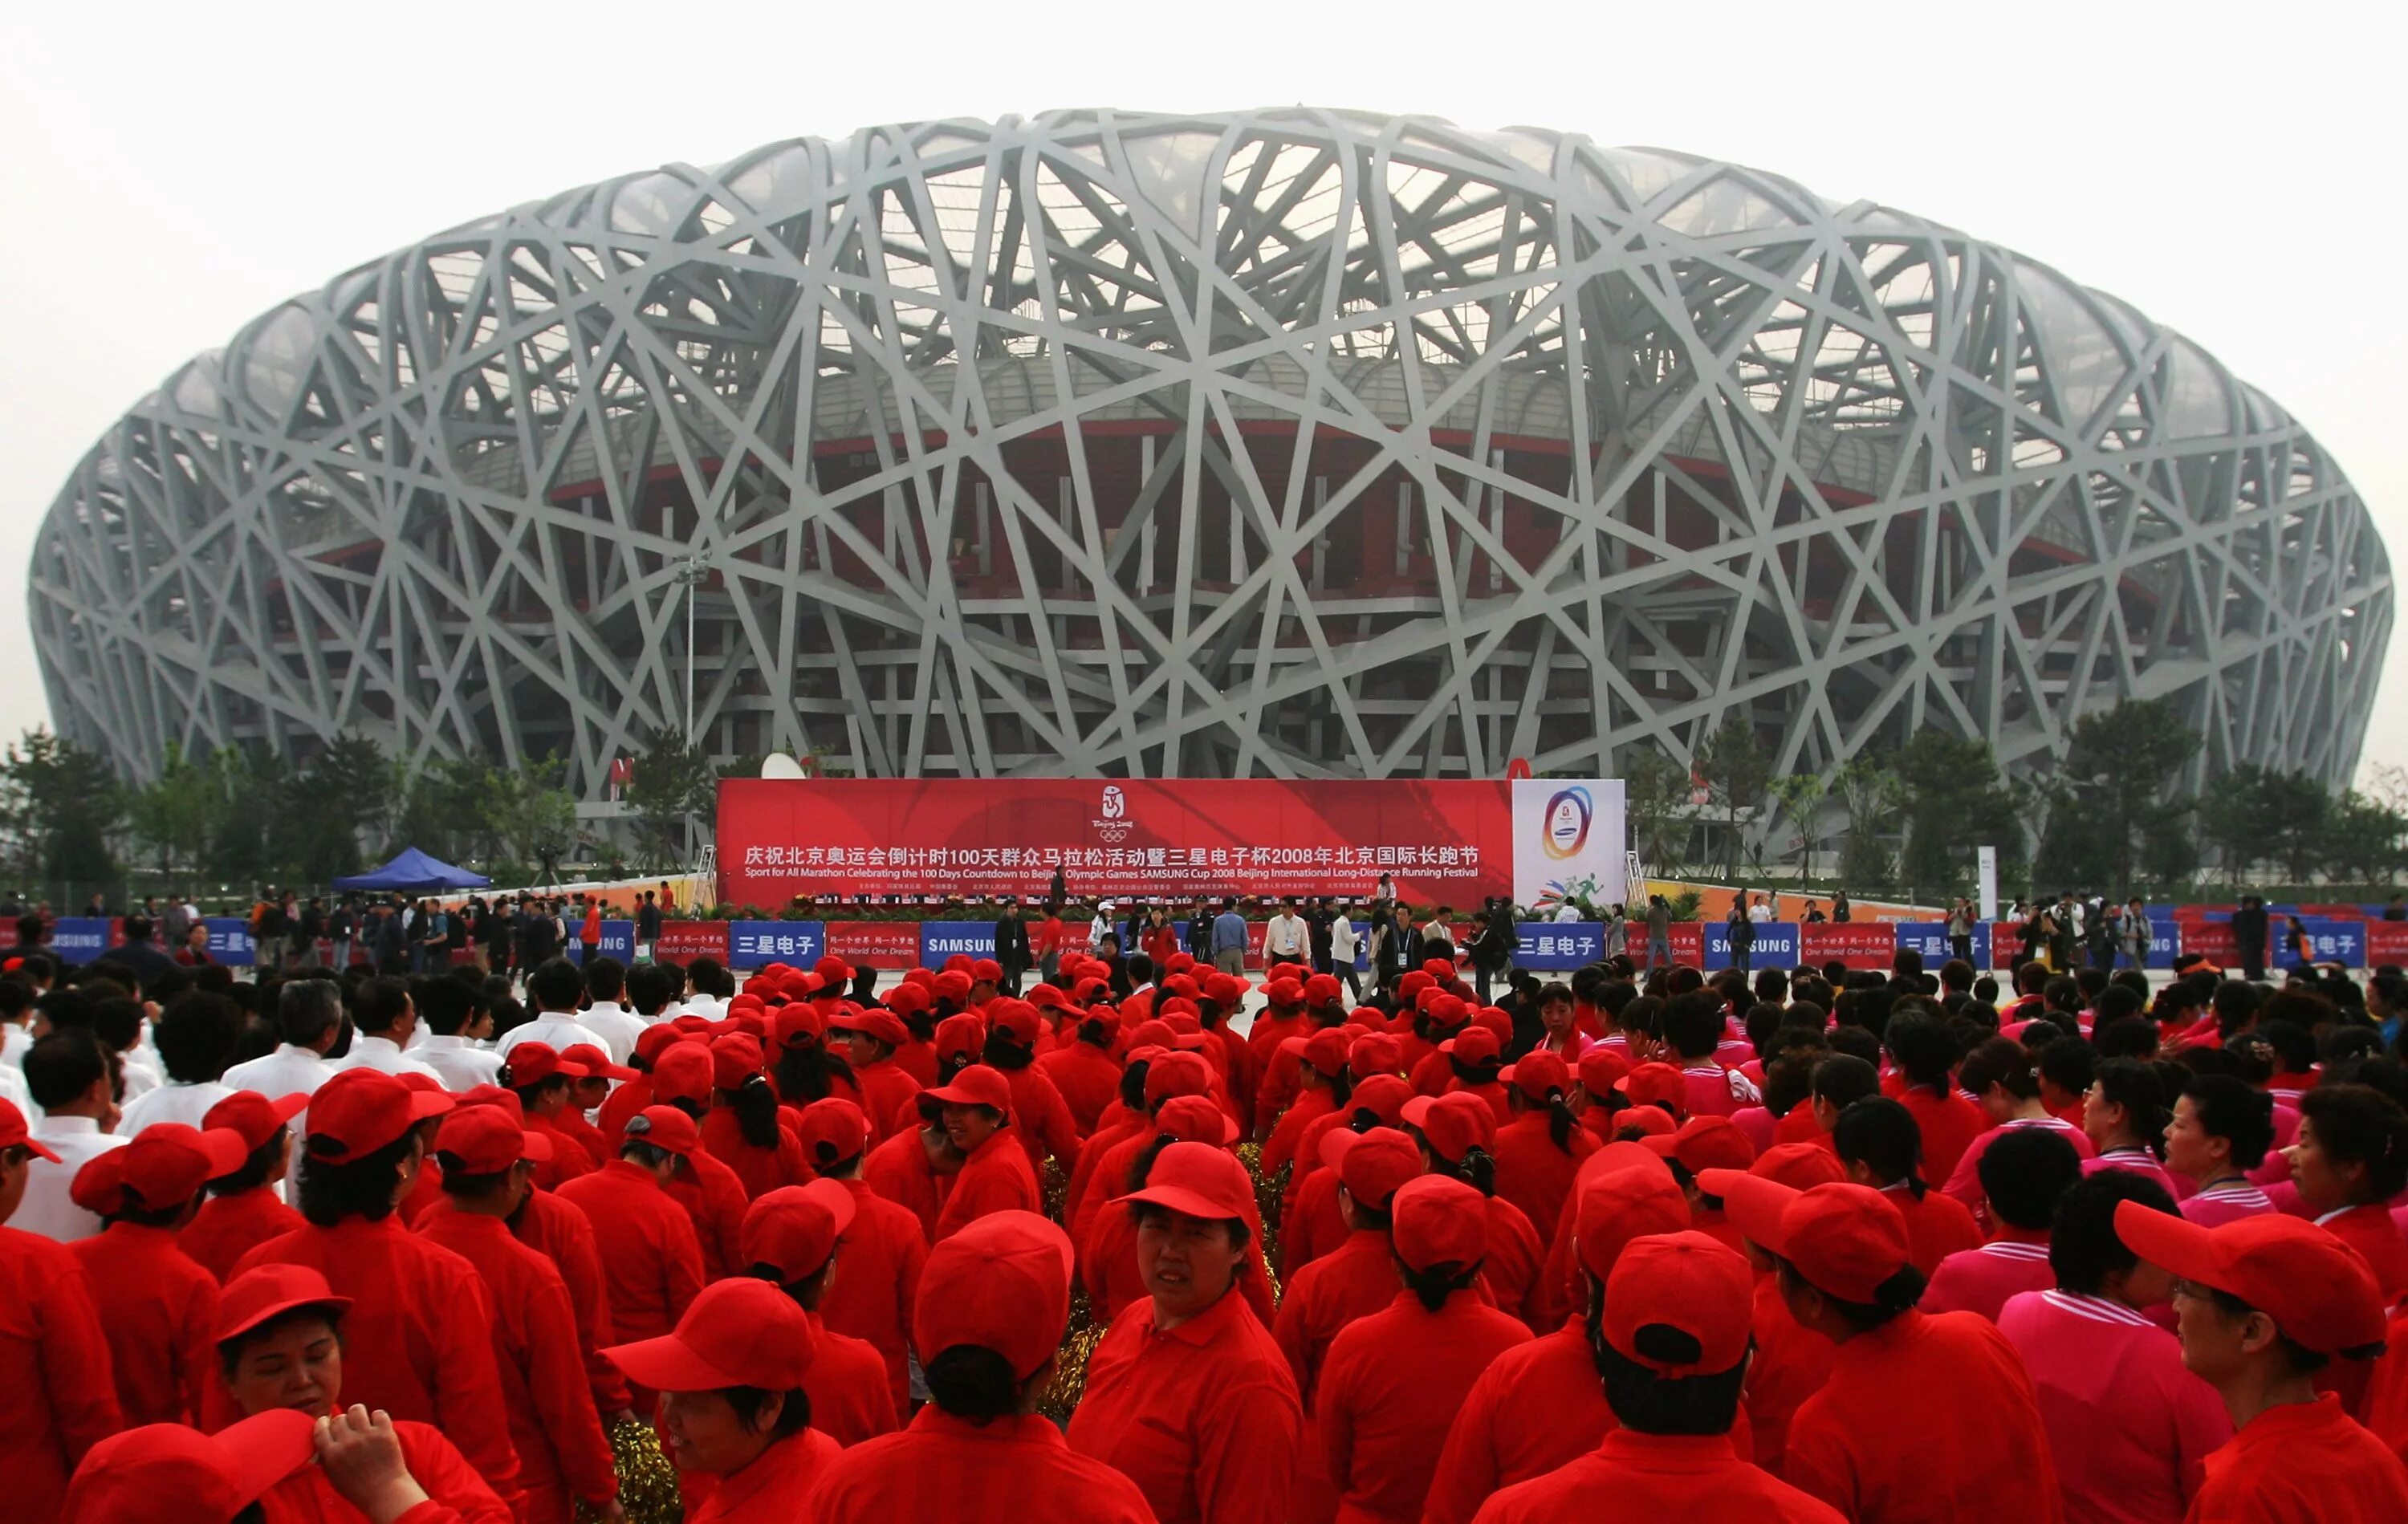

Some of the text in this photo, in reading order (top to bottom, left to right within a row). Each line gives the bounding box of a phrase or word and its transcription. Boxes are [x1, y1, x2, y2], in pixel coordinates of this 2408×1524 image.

[745, 868, 771, 879] Sport
[771, 868, 785, 877] for
[787, 868, 799, 876] All
[801, 868, 845, 877] Marathon
[847, 868, 900, 880] Celebrating
[901, 868, 918, 878] the
[921, 869, 938, 878] 100
[938, 869, 962, 880] Days
[962, 869, 1018, 879] Countdown
[1019, 870, 1030, 879] to
[1031, 869, 1057, 880] Beijin
[1065, 869, 1104, 880] Olympic
[1106, 869, 1139, 879] Games
[1140, 869, 1190, 879] SAMSUNG
[1190, 869, 1210, 880] Cup
[1212, 869, 1235, 878] 2008
[1237, 868, 1270, 880] Beijing
[1271, 868, 1331, 878] International
[1401, 867, 1442, 879] Running
[1443, 867, 1479, 877] Festival
[568, 937, 625, 950] MUNG
[738, 935, 815, 956] 三星电子
[830, 936, 914, 945] 同一个世界 同一个梦想
[929, 937, 995, 953] SAMSUN
[1712, 938, 1791, 953] SASUNG
[1849, 937, 1889, 945] 同一个梦想
[699, 946, 723, 954] Dream
[830, 947, 914, 956] One World One Dream
[1517, 937, 1596, 956] 三星电子
[1672, 948, 1697, 956] Dream
[1806, 948, 1889, 956] One World One Dream
